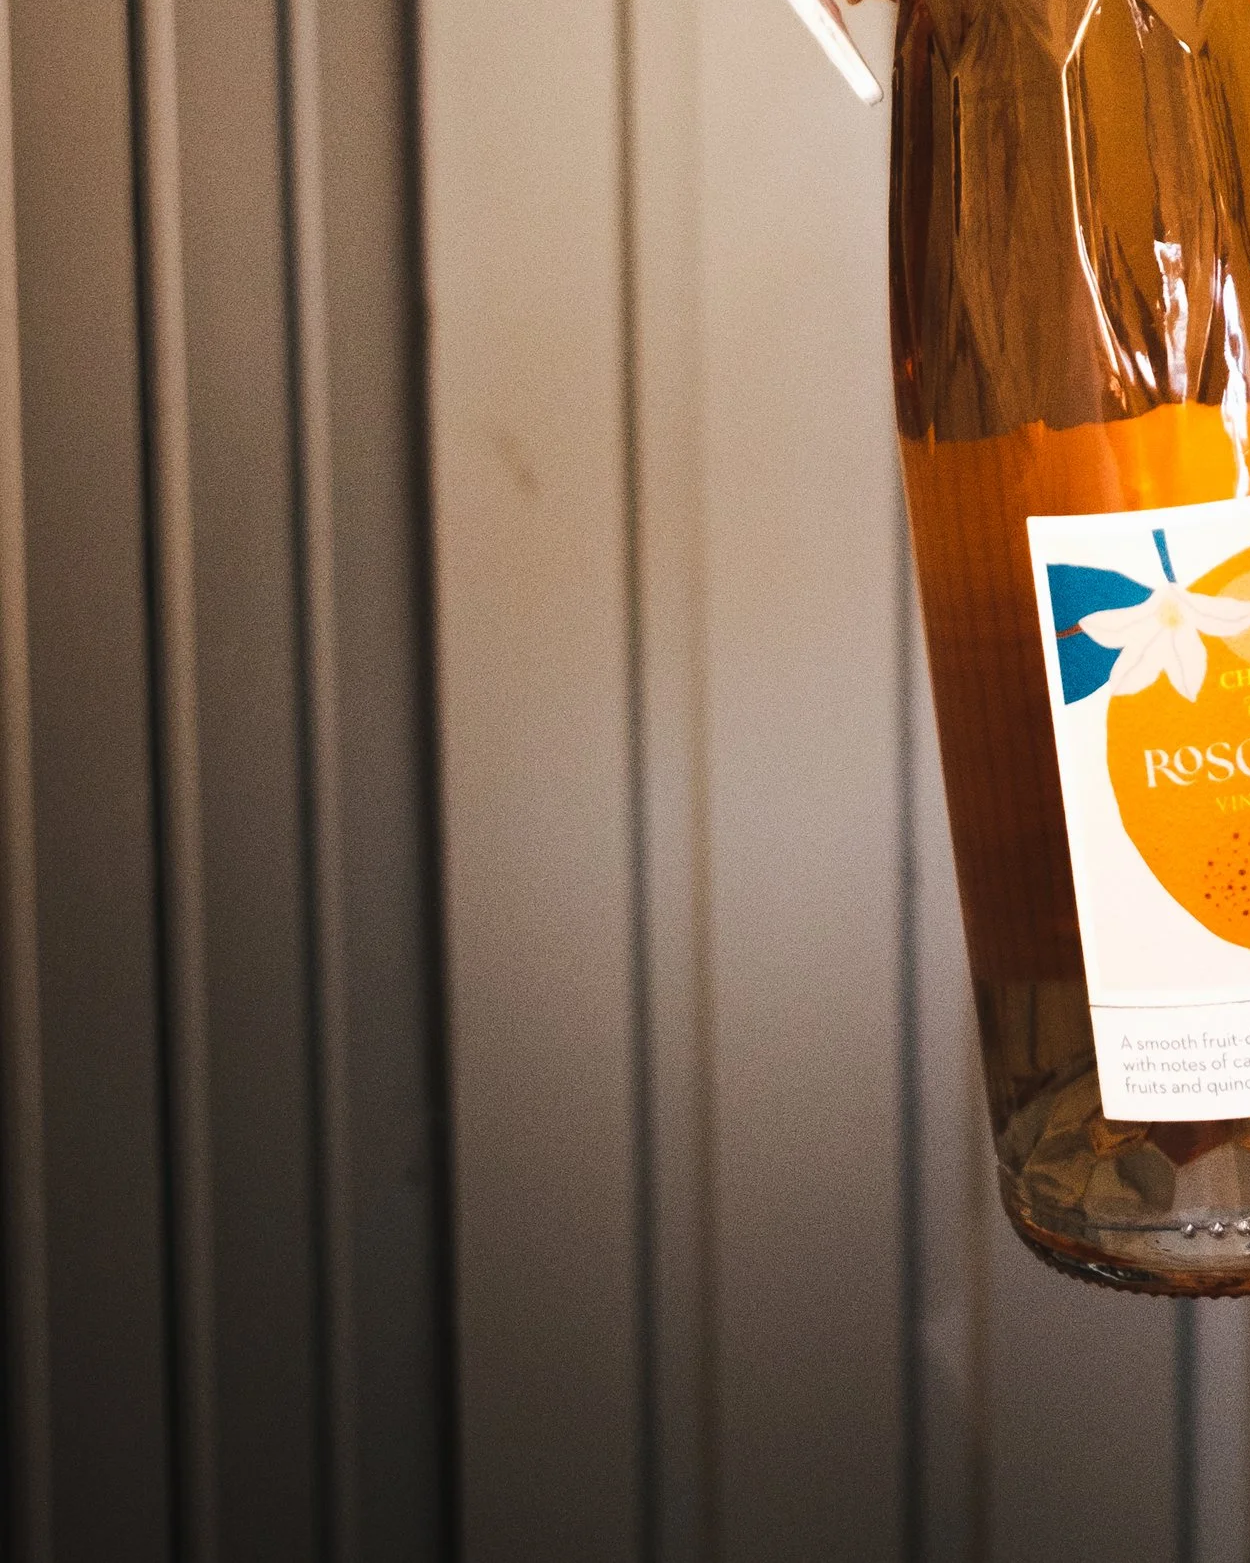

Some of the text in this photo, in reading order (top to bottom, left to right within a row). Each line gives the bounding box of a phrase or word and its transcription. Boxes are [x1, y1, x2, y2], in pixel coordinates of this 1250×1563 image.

[1120, 1034, 1133, 1051] A
[1136, 1032, 1199, 1052] smooth
[1122, 1054, 1157, 1073] with
[1160, 1056, 1207, 1073] notes
[1211, 1052, 1229, 1071] of
[1124, 1076, 1168, 1095] fruits
[1171, 1075, 1202, 1094] and
